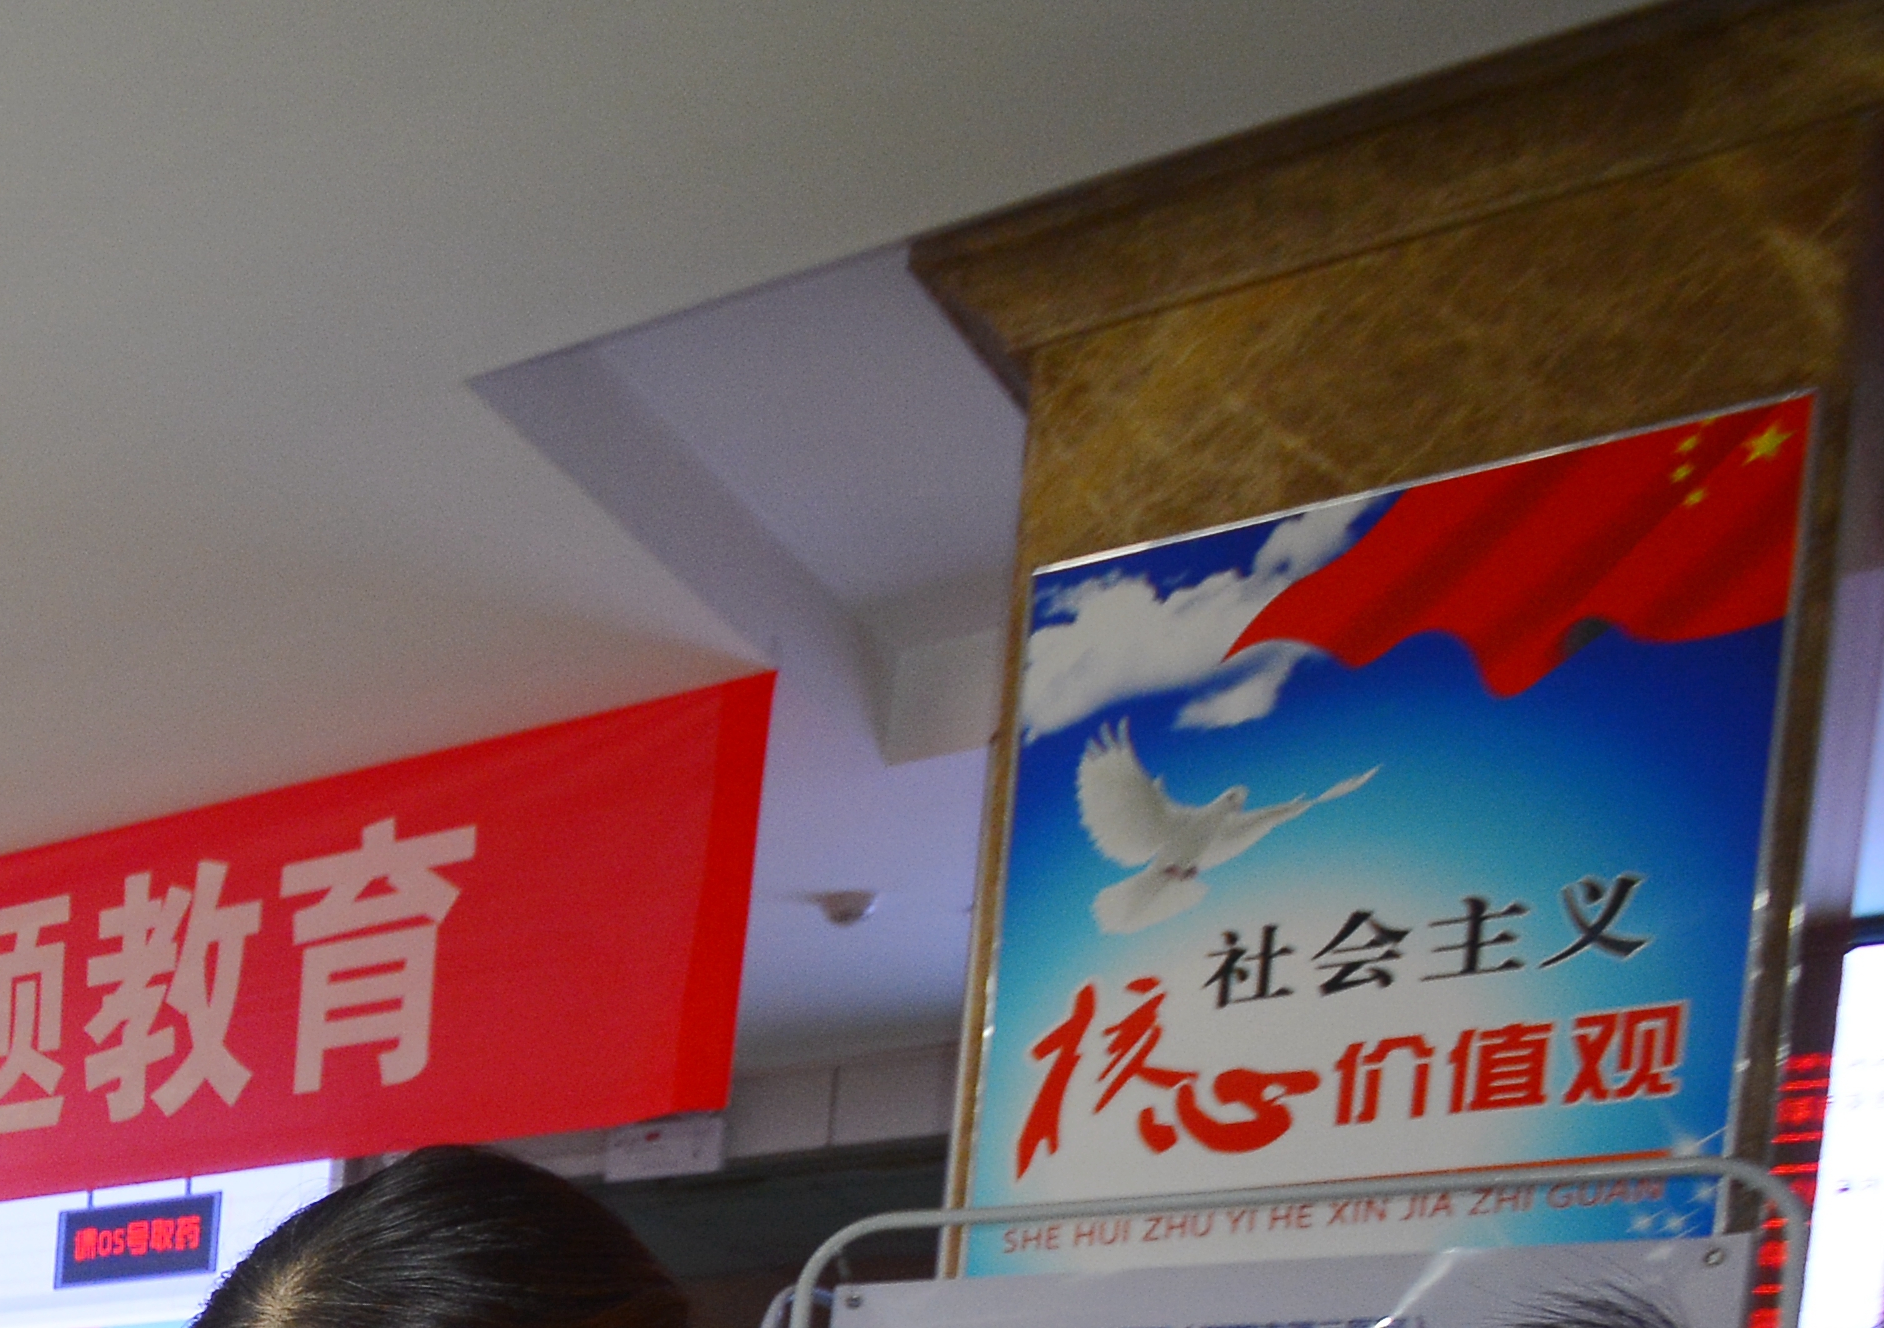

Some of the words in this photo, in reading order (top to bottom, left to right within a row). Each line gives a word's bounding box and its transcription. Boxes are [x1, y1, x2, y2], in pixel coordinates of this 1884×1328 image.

[1203, 870, 1649, 1009] 社会主义
[1015, 975, 1690, 1182] 核心价值观
[1002, 1226, 1060, 1255] SHE
[1072, 1221, 1131, 1247] HUI
[1142, 1212, 1214, 1243] ZHU
[1228, 1207, 1259, 1235] YI
[1269, 1203, 1315, 1230] HE
[1326, 1197, 1387, 1227] XIN
[1400, 1191, 1454, 1222] JIA
[1467, 1184, 1532, 1215] ZHI
